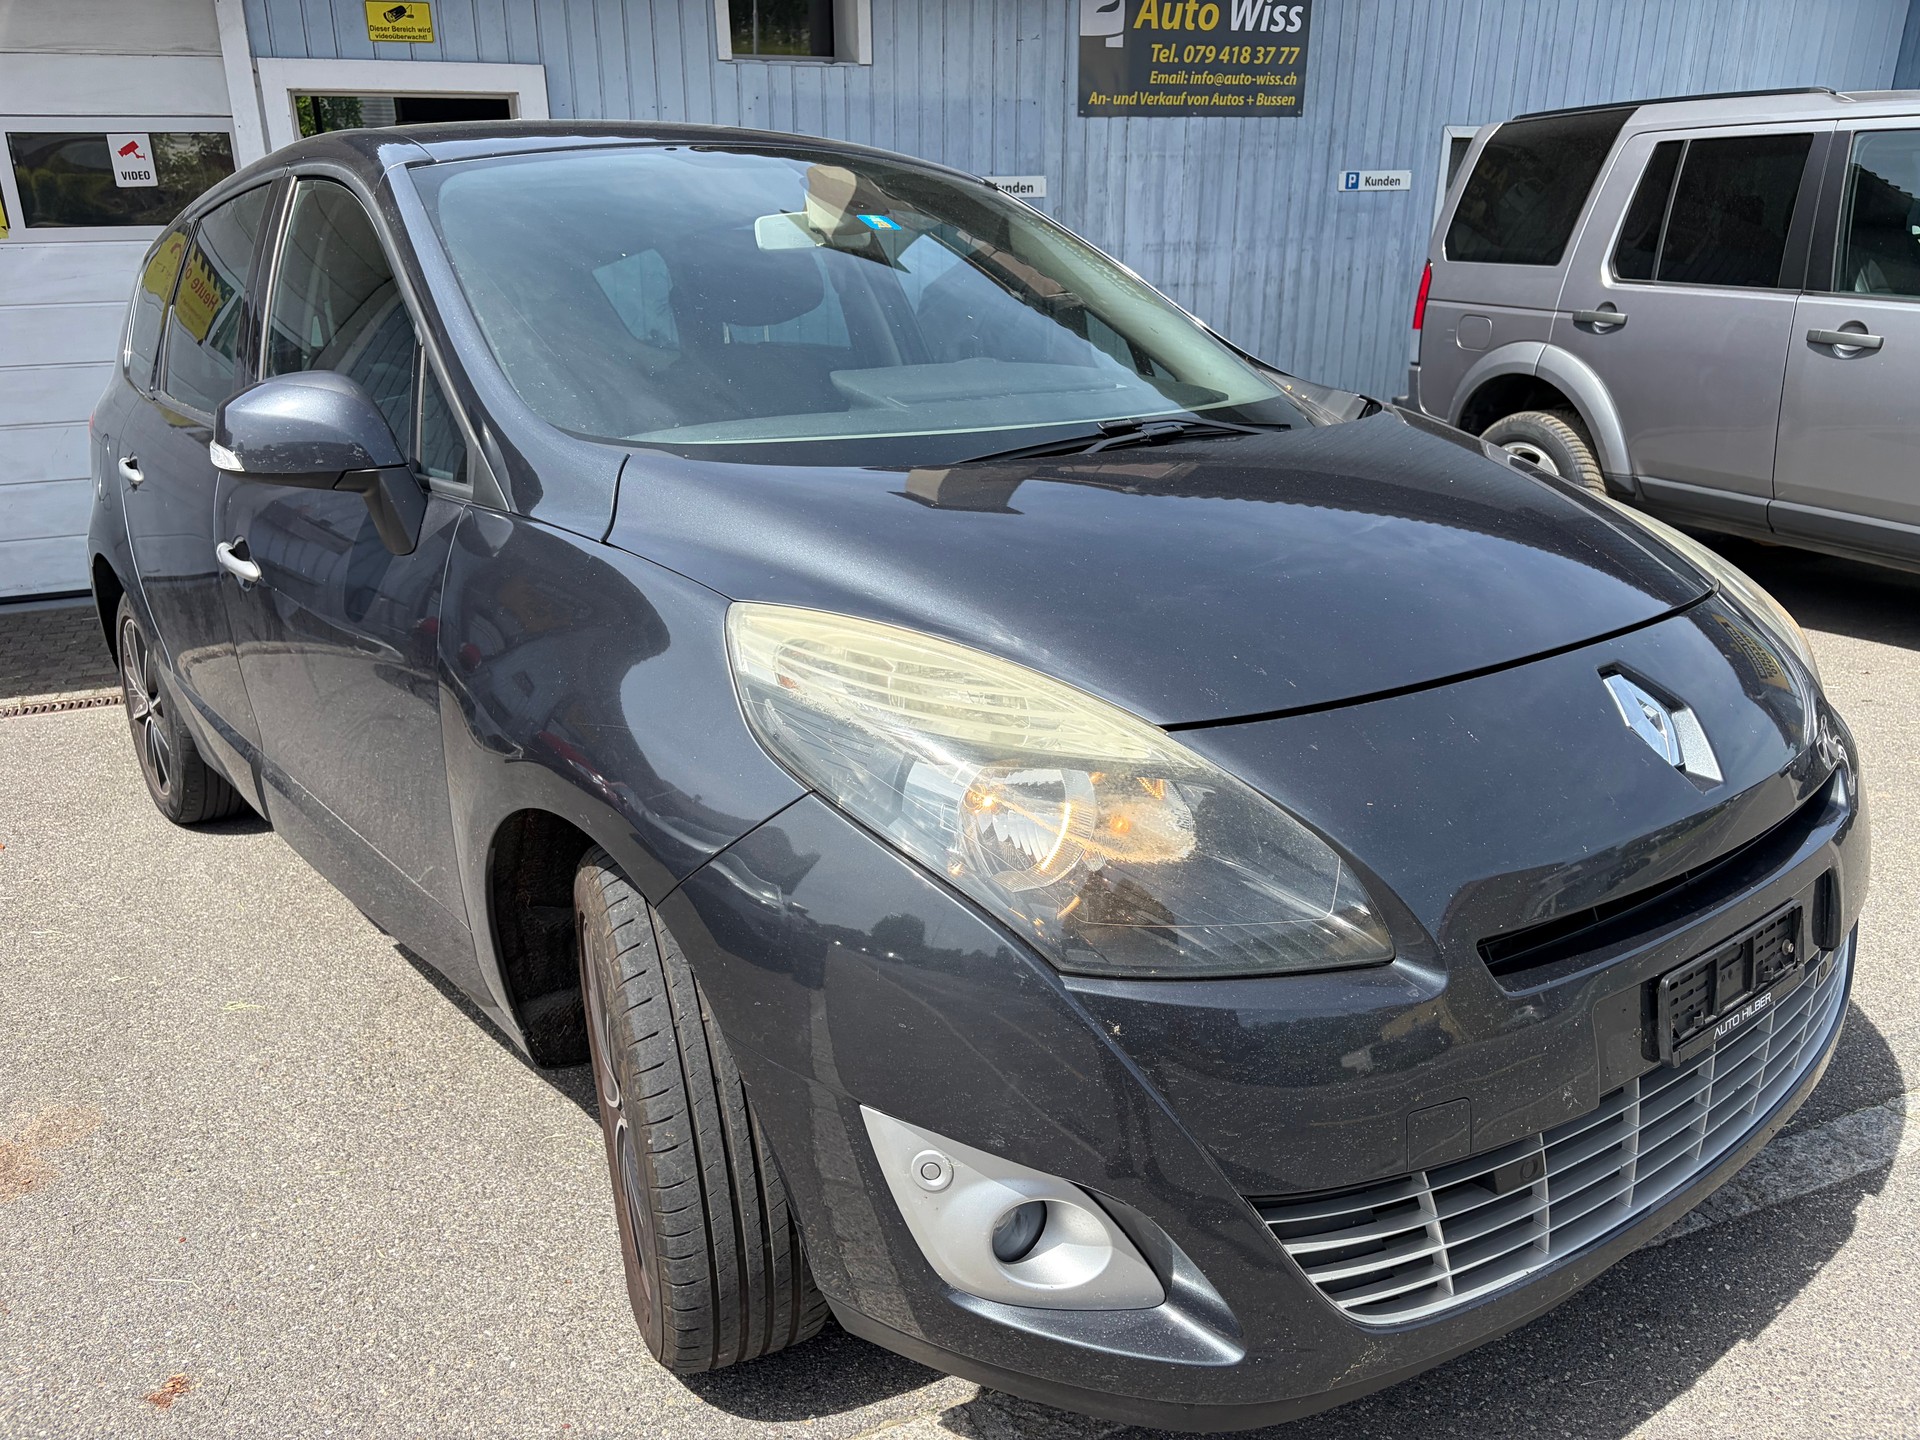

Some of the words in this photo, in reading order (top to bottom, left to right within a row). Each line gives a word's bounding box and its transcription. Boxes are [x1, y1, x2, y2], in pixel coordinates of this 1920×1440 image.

[1133, 0, 1220, 31] Auto
[1230, 0, 1304, 33] Wiss
[1151, 43, 1179, 63] Tel.
[1183, 45, 1216, 63] 079
[1218, 46, 1252, 64] 418
[1253, 46, 1276, 64] 37
[1278, 46, 1300, 65] 77
[1150, 71, 1188, 85] Email:
[1190, 71, 1297, 86] info@auto-wiss.ch
[1088, 91, 1111, 105] An-
[1113, 91, 1138, 106] und
[1139, 92, 1187, 106] Verkauf
[1187, 96, 1208, 106] von
[1210, 93, 1244, 106] Autos
[1246, 96, 1254, 105] +
[1256, 93, 1296, 106] Bussen
[121, 171, 151, 180] VIDEO
[1348, 174, 1357, 188] P
[1364, 176, 1401, 187] Kunden
[994, 182, 1034, 193] nden
[1713, 1013, 1740, 1040] AUTO
